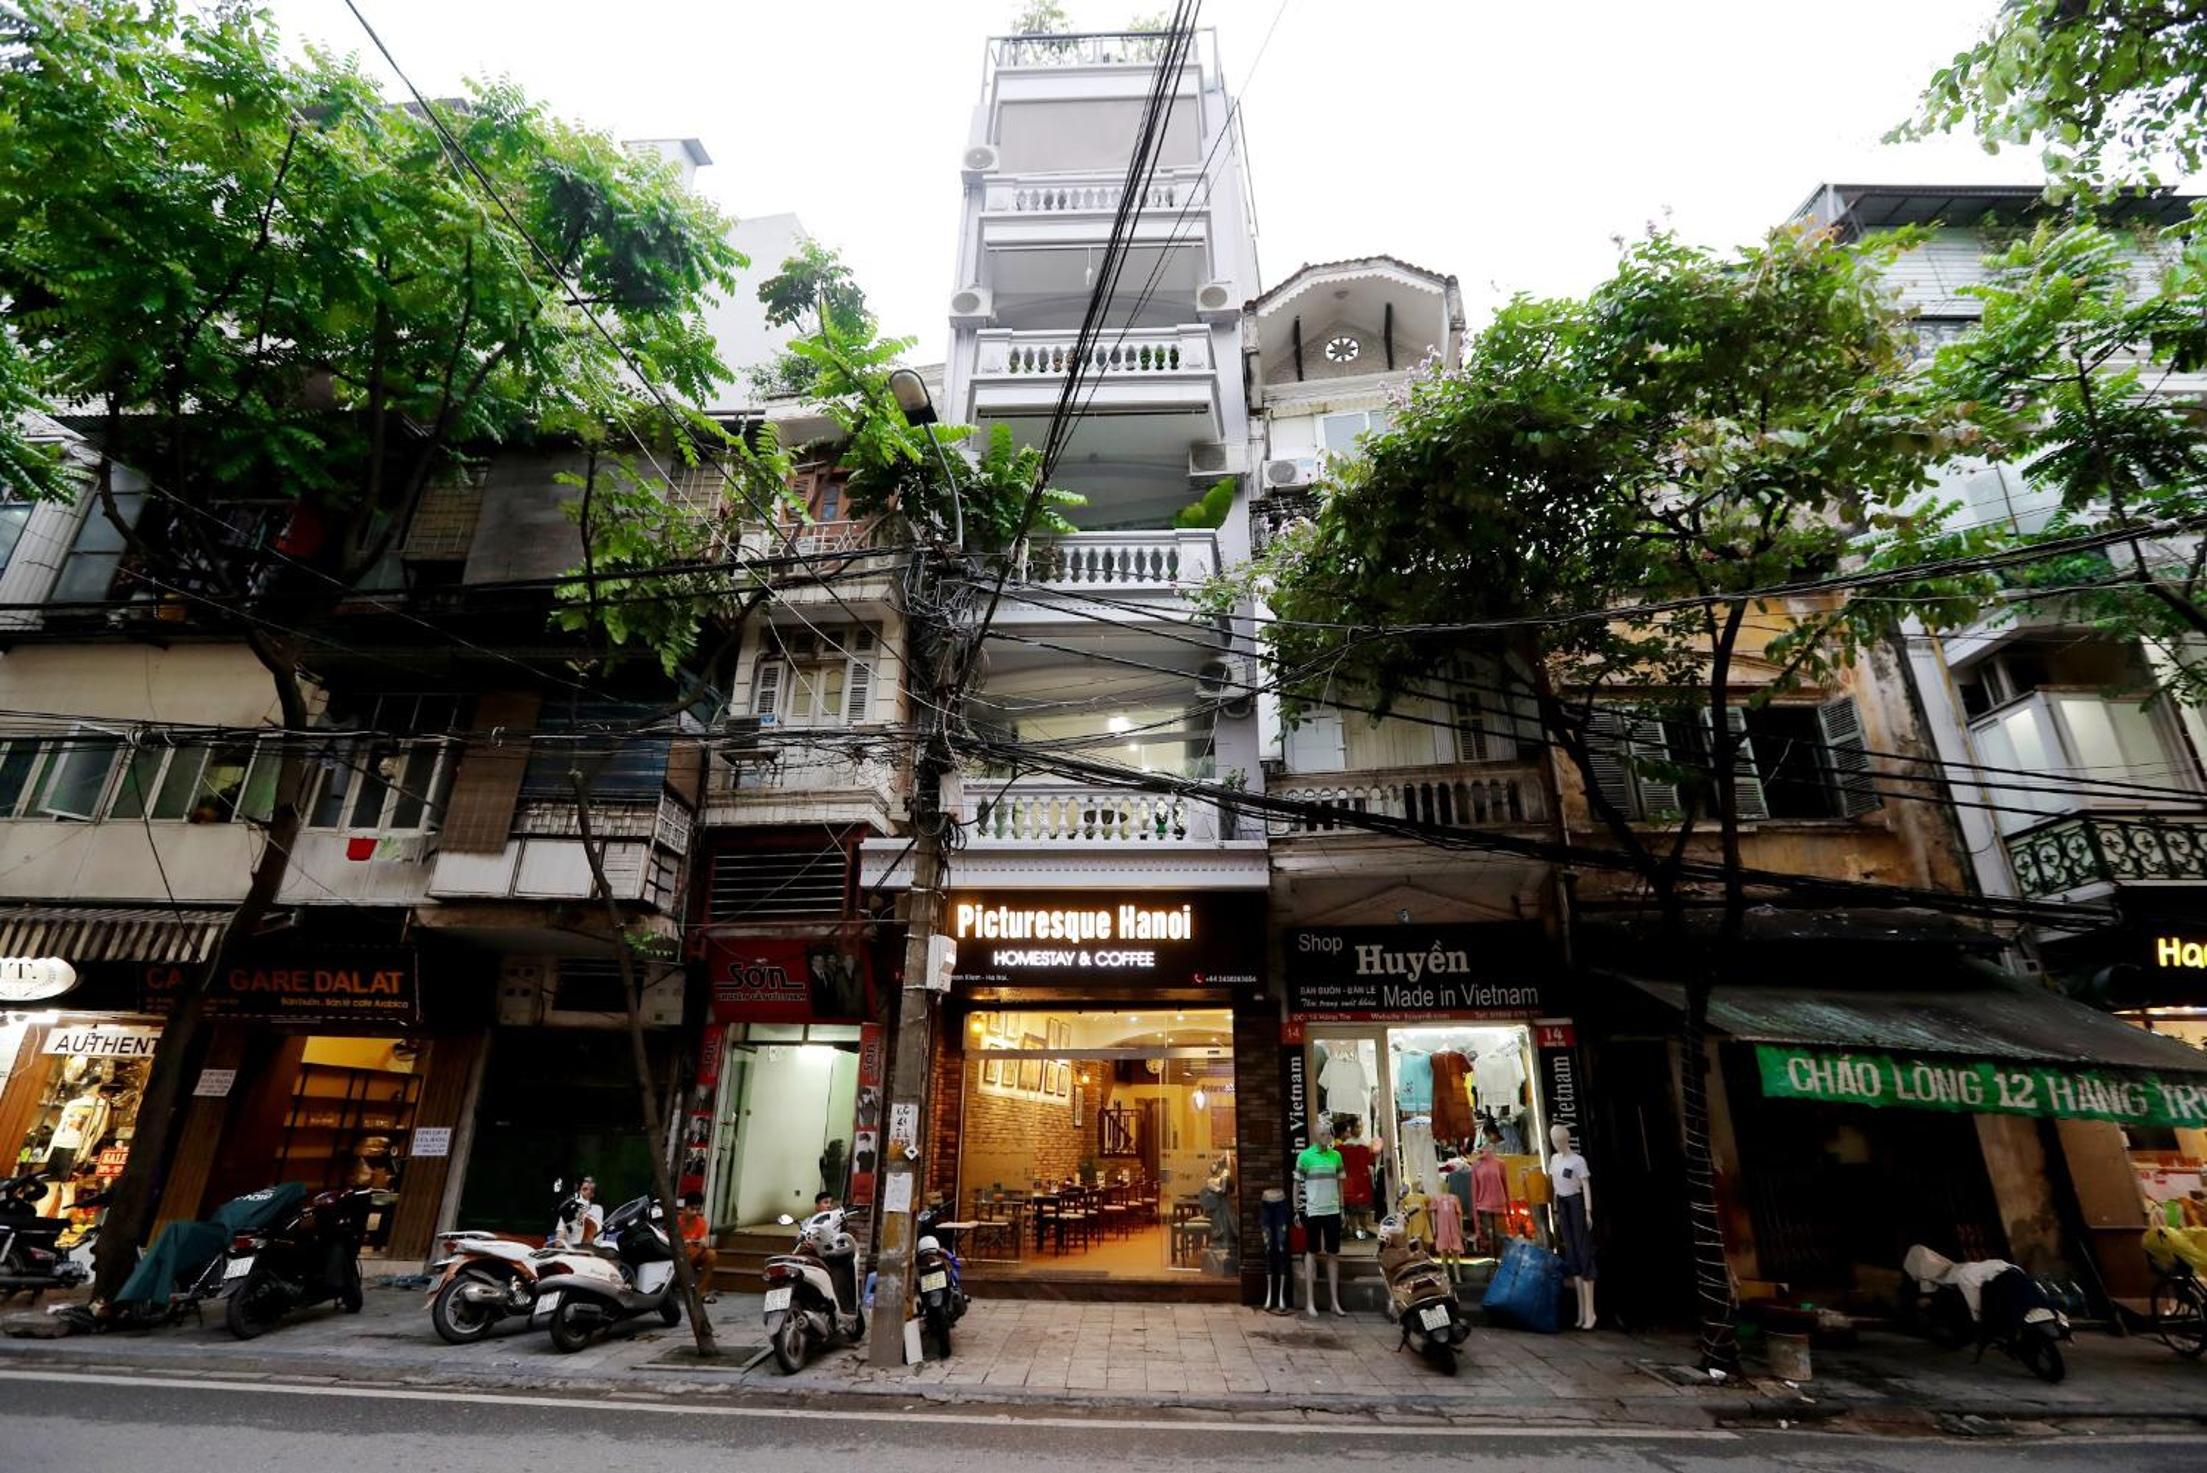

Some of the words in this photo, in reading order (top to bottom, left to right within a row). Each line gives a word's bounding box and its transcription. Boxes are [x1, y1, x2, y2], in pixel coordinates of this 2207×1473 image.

[957, 904, 1111, 943] Picturesque
[1119, 905, 1192, 940] Hanoi
[993, 951, 1076, 967] HOMESTAY
[1079, 951, 1092, 967] &
[1095, 951, 1155, 967] COFFEE
[1298, 934, 1343, 955] Shop
[1355, 940, 1470, 982] Huyền
[2158, 937, 2207, 968] Ha
[227, 968, 310, 993] GARE
[314, 969, 405, 994] DALAT
[1383, 985, 1434, 1008] Made
[1440, 985, 1456, 1006] in
[1461, 984, 1539, 1006] Vietnam
[1544, 1027, 1563, 1040] 14
[1289, 1055, 1305, 1131] Vietnam
[1787, 1053, 1882, 1097] CHÁO
[1895, 1060, 1984, 1106] LÒNG
[1993, 1072, 2037, 1109] 12
[2045, 1073, 2148, 1116] HÀNG
